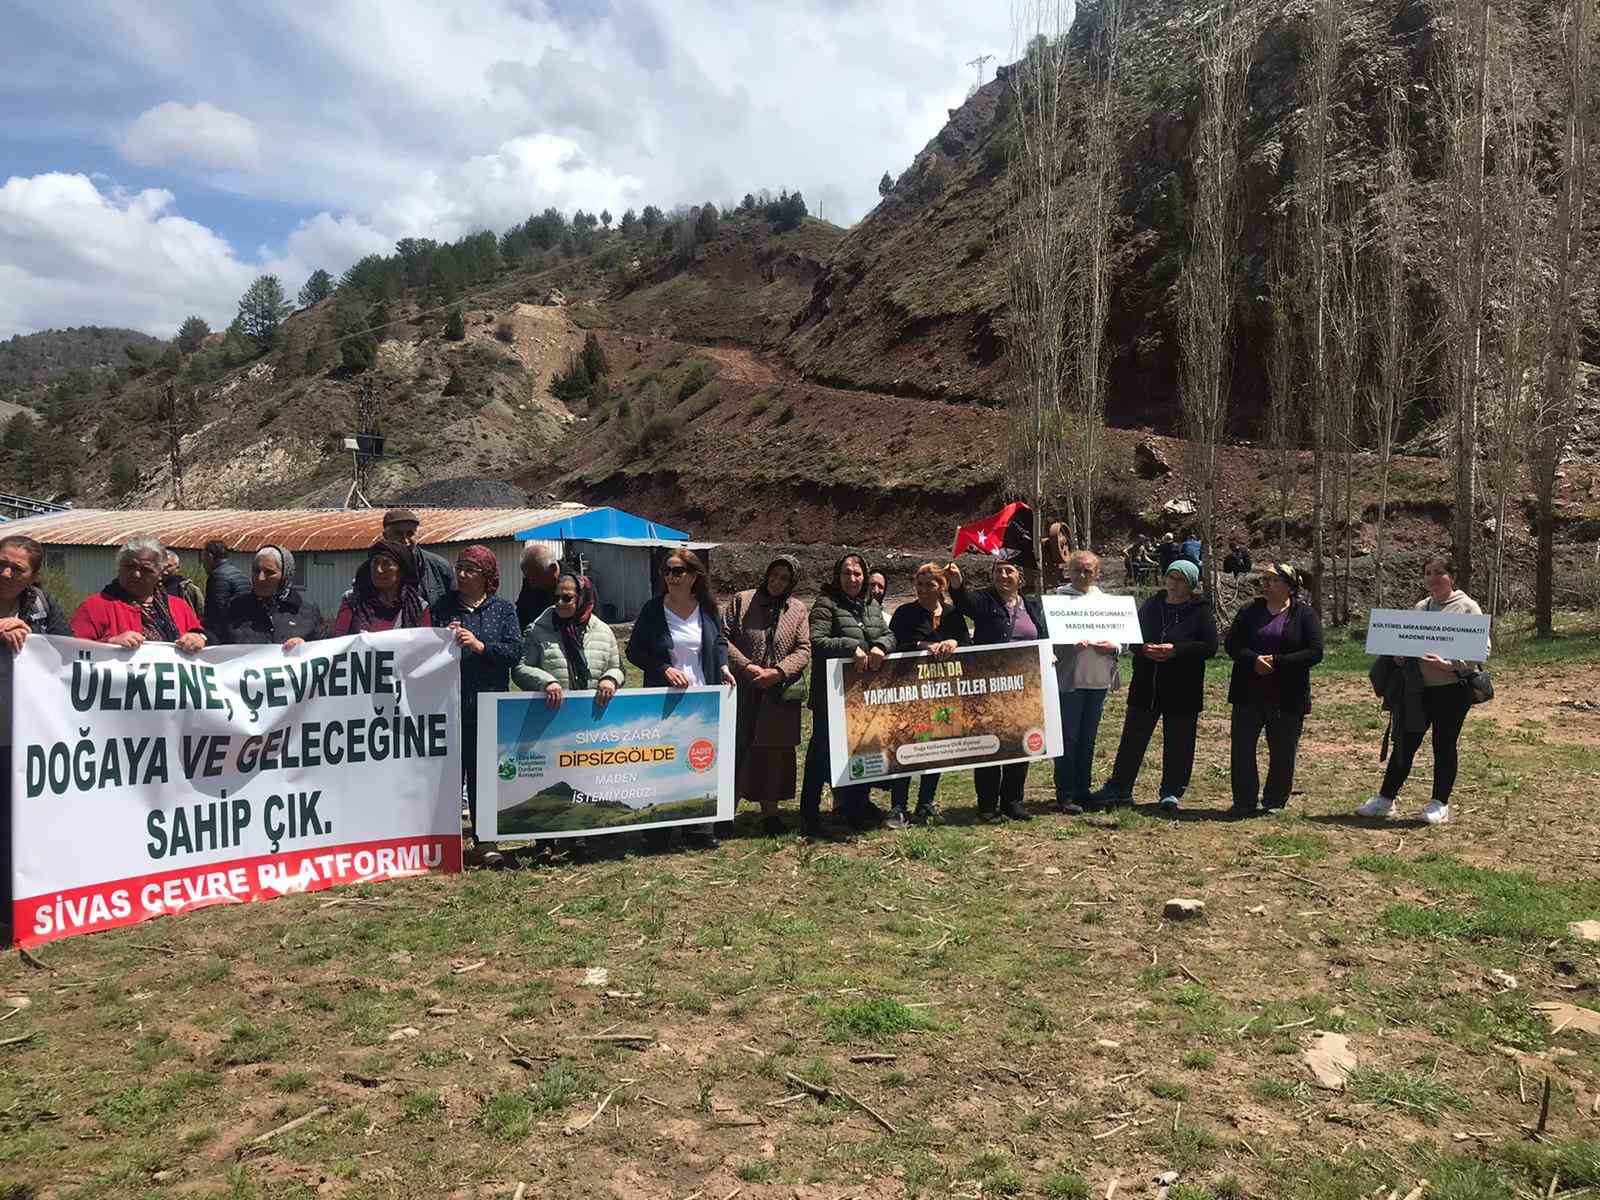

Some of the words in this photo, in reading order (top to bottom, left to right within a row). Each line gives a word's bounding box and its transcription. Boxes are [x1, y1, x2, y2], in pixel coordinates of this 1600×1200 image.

[917, 661, 963, 679] ZARA'DA
[71, 650, 233, 721] ÜLKENE,
[240, 651, 402, 722] ÇEVRENE,
[863, 686, 919, 705] YARINLARA
[921, 681, 954, 699] GÜZEL
[957, 678, 987, 695] İZLER
[990, 675, 1024, 691] BIRAK!
[575, 729, 619, 744] SİVAS
[623, 727, 661, 741] ZARA
[26, 727, 168, 798] DOĞAYA
[182, 735, 229, 779] VE
[236, 706, 448, 773] GELECEĞİNE
[559, 746, 675, 768] DİPSİZGÖL'DE
[594, 772, 639, 785] MADEN
[146, 789, 251, 859] SAHİP
[263, 790, 333, 854] ÇIK.
[33, 895, 132, 935] SİVAS
[140, 867, 250, 914] ÇEVRE
[259, 844, 443, 886] PLATFORMU
